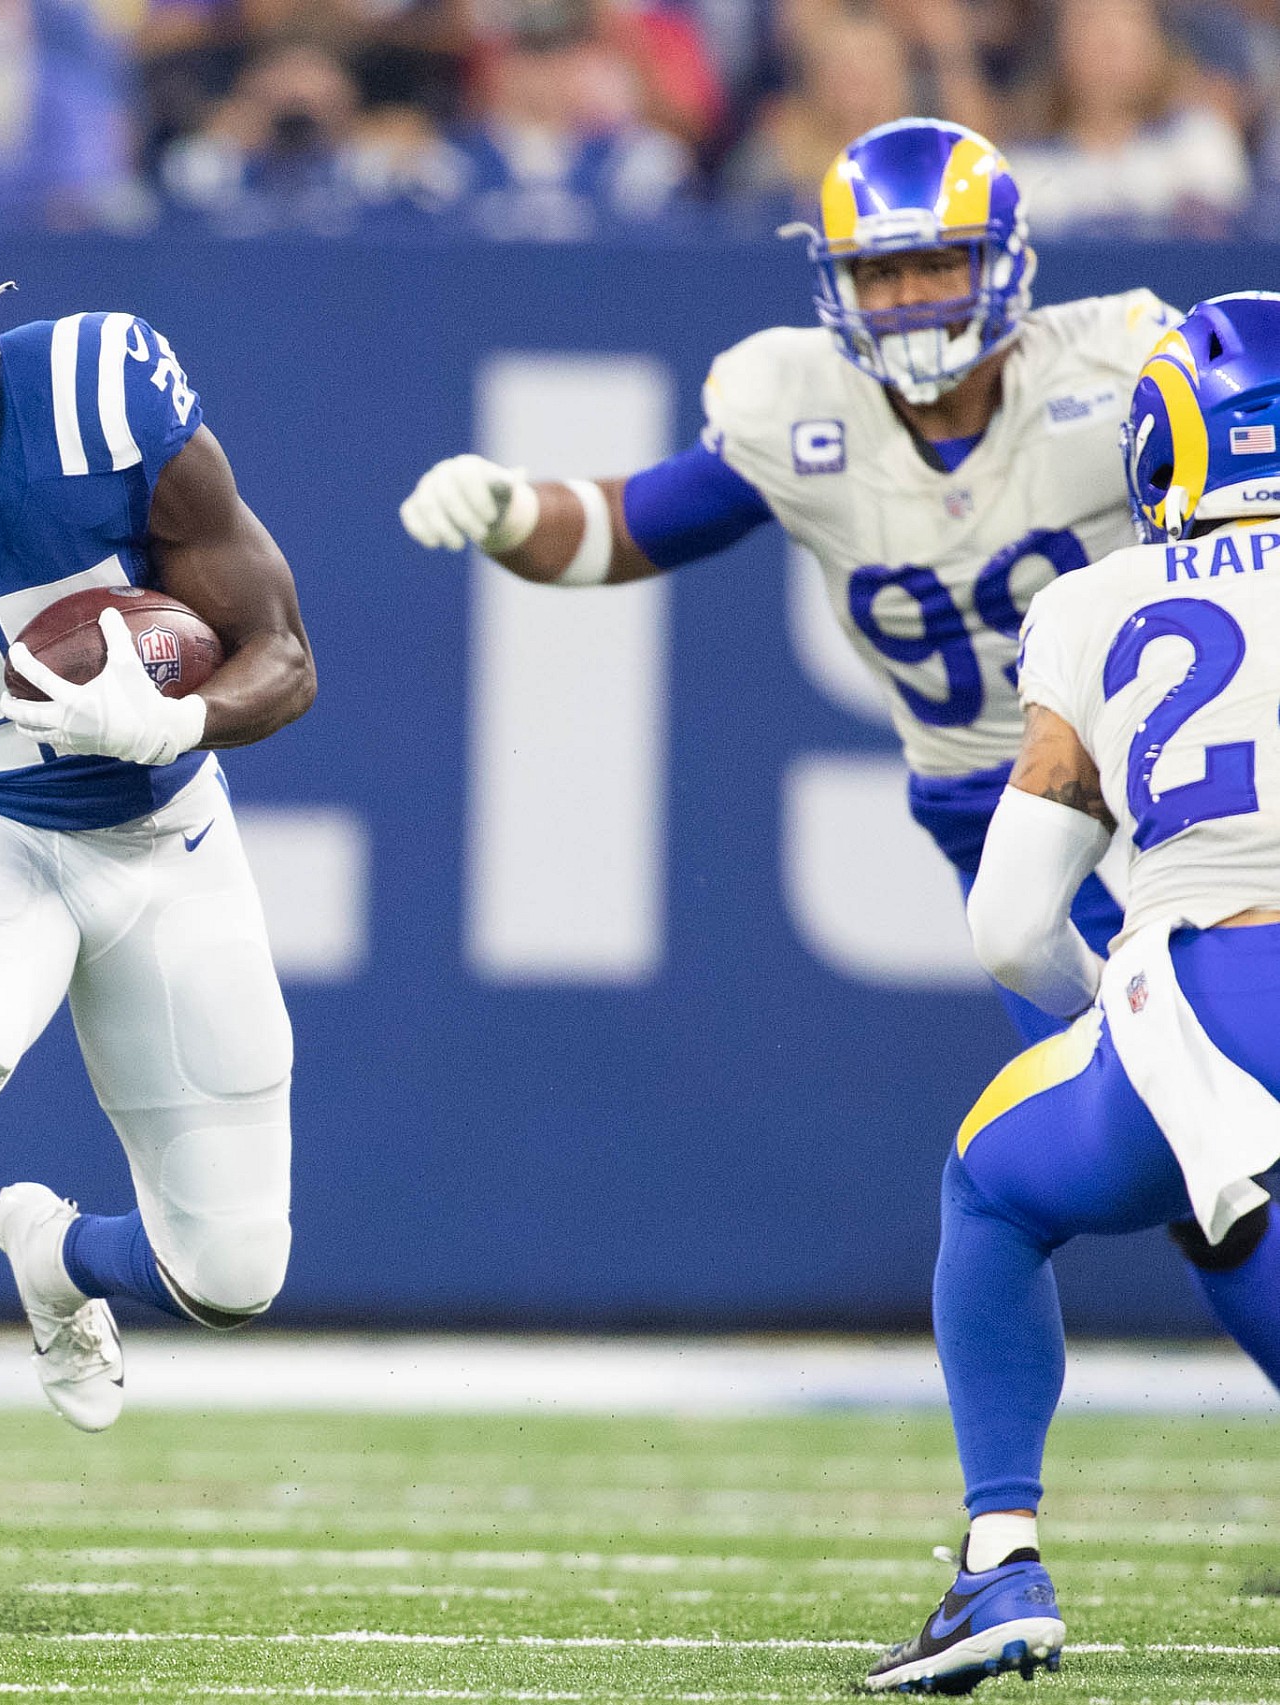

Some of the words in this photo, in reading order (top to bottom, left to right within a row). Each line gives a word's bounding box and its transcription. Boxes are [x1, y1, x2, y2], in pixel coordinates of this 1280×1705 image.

[796, 423, 841, 462] C
[1166, 534, 1280, 582] RAP
[143, 633, 178, 661] NFL
[847, 526, 1090, 728] 99
[1103, 597, 1280, 853] 2
